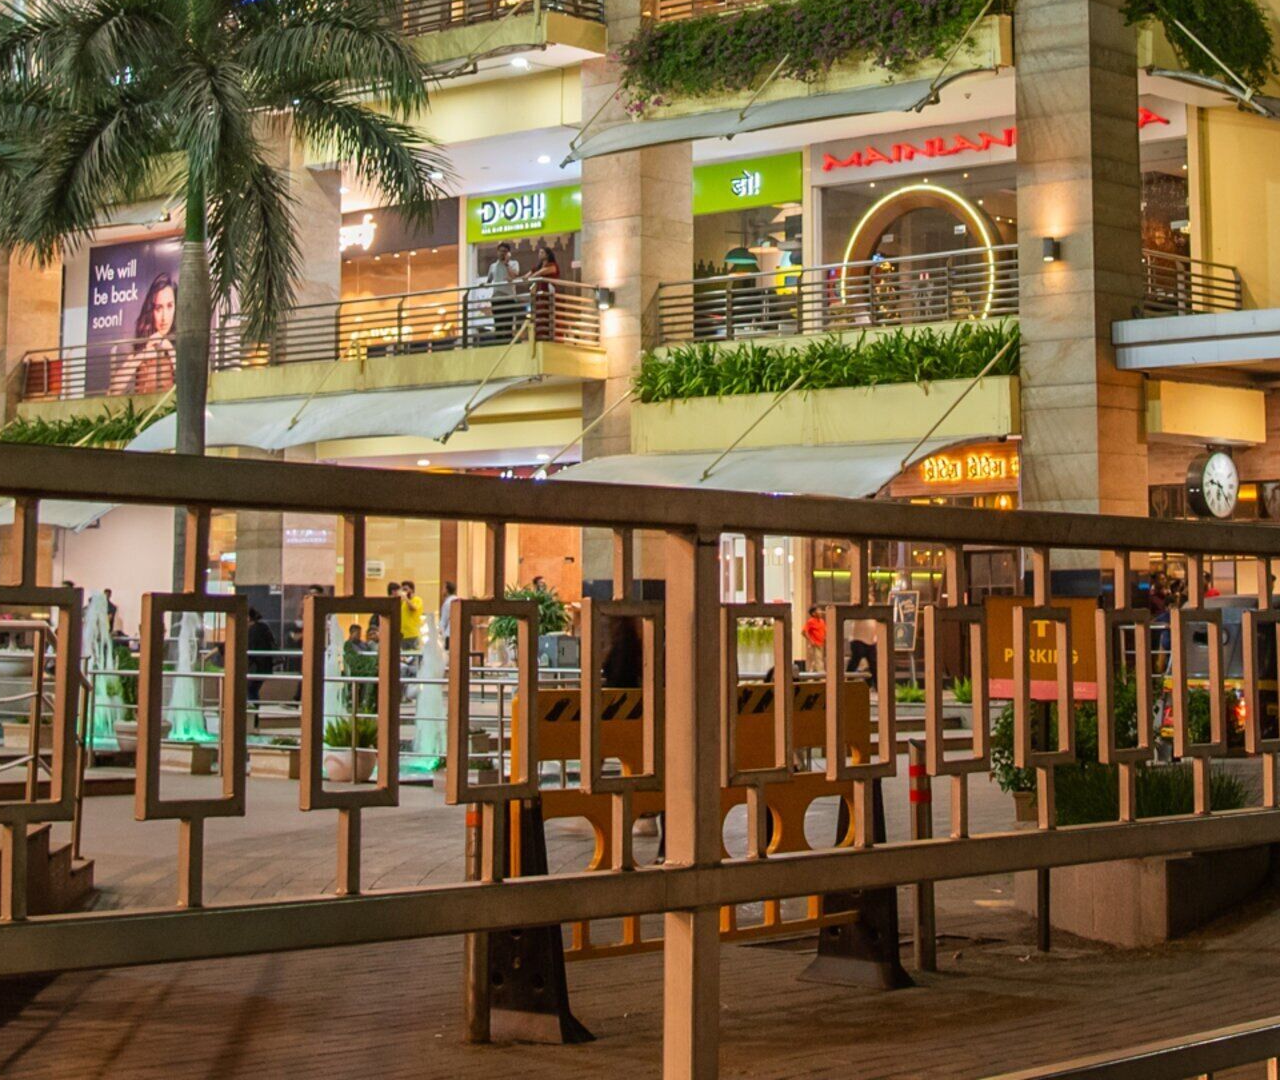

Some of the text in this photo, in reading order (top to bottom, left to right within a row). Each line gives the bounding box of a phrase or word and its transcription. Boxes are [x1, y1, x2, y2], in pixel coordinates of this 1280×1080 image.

[823, 126, 1016, 171] MAINLAN
[95, 258, 138, 282] We will
[93, 283, 138, 306] be back
[92, 309, 123, 329] soon!
